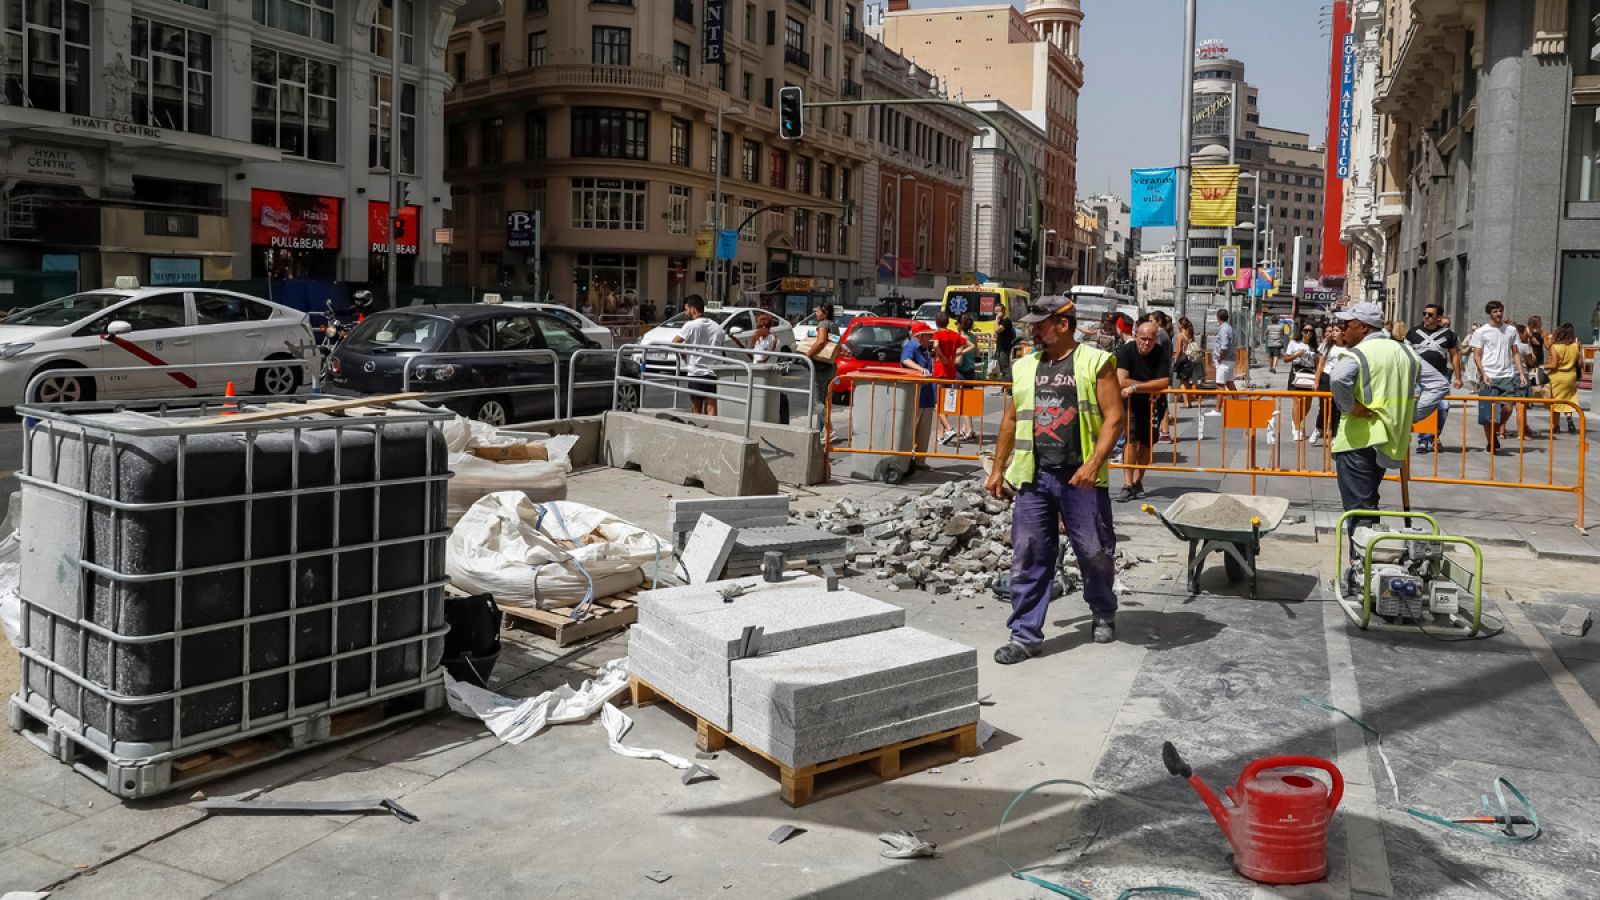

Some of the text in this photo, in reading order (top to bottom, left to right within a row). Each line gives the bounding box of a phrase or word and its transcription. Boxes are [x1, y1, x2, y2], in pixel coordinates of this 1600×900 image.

[707, 0, 721, 60] NTE
[1338, 35, 1354, 176] HOTEL ATLANTICO
[72, 117, 161, 137] HYATT CENTRIC
[34, 149, 68, 160] HYATT
[27, 157, 77, 170] CENTRIC
[271, 236, 324, 249] PULL&BEAR
